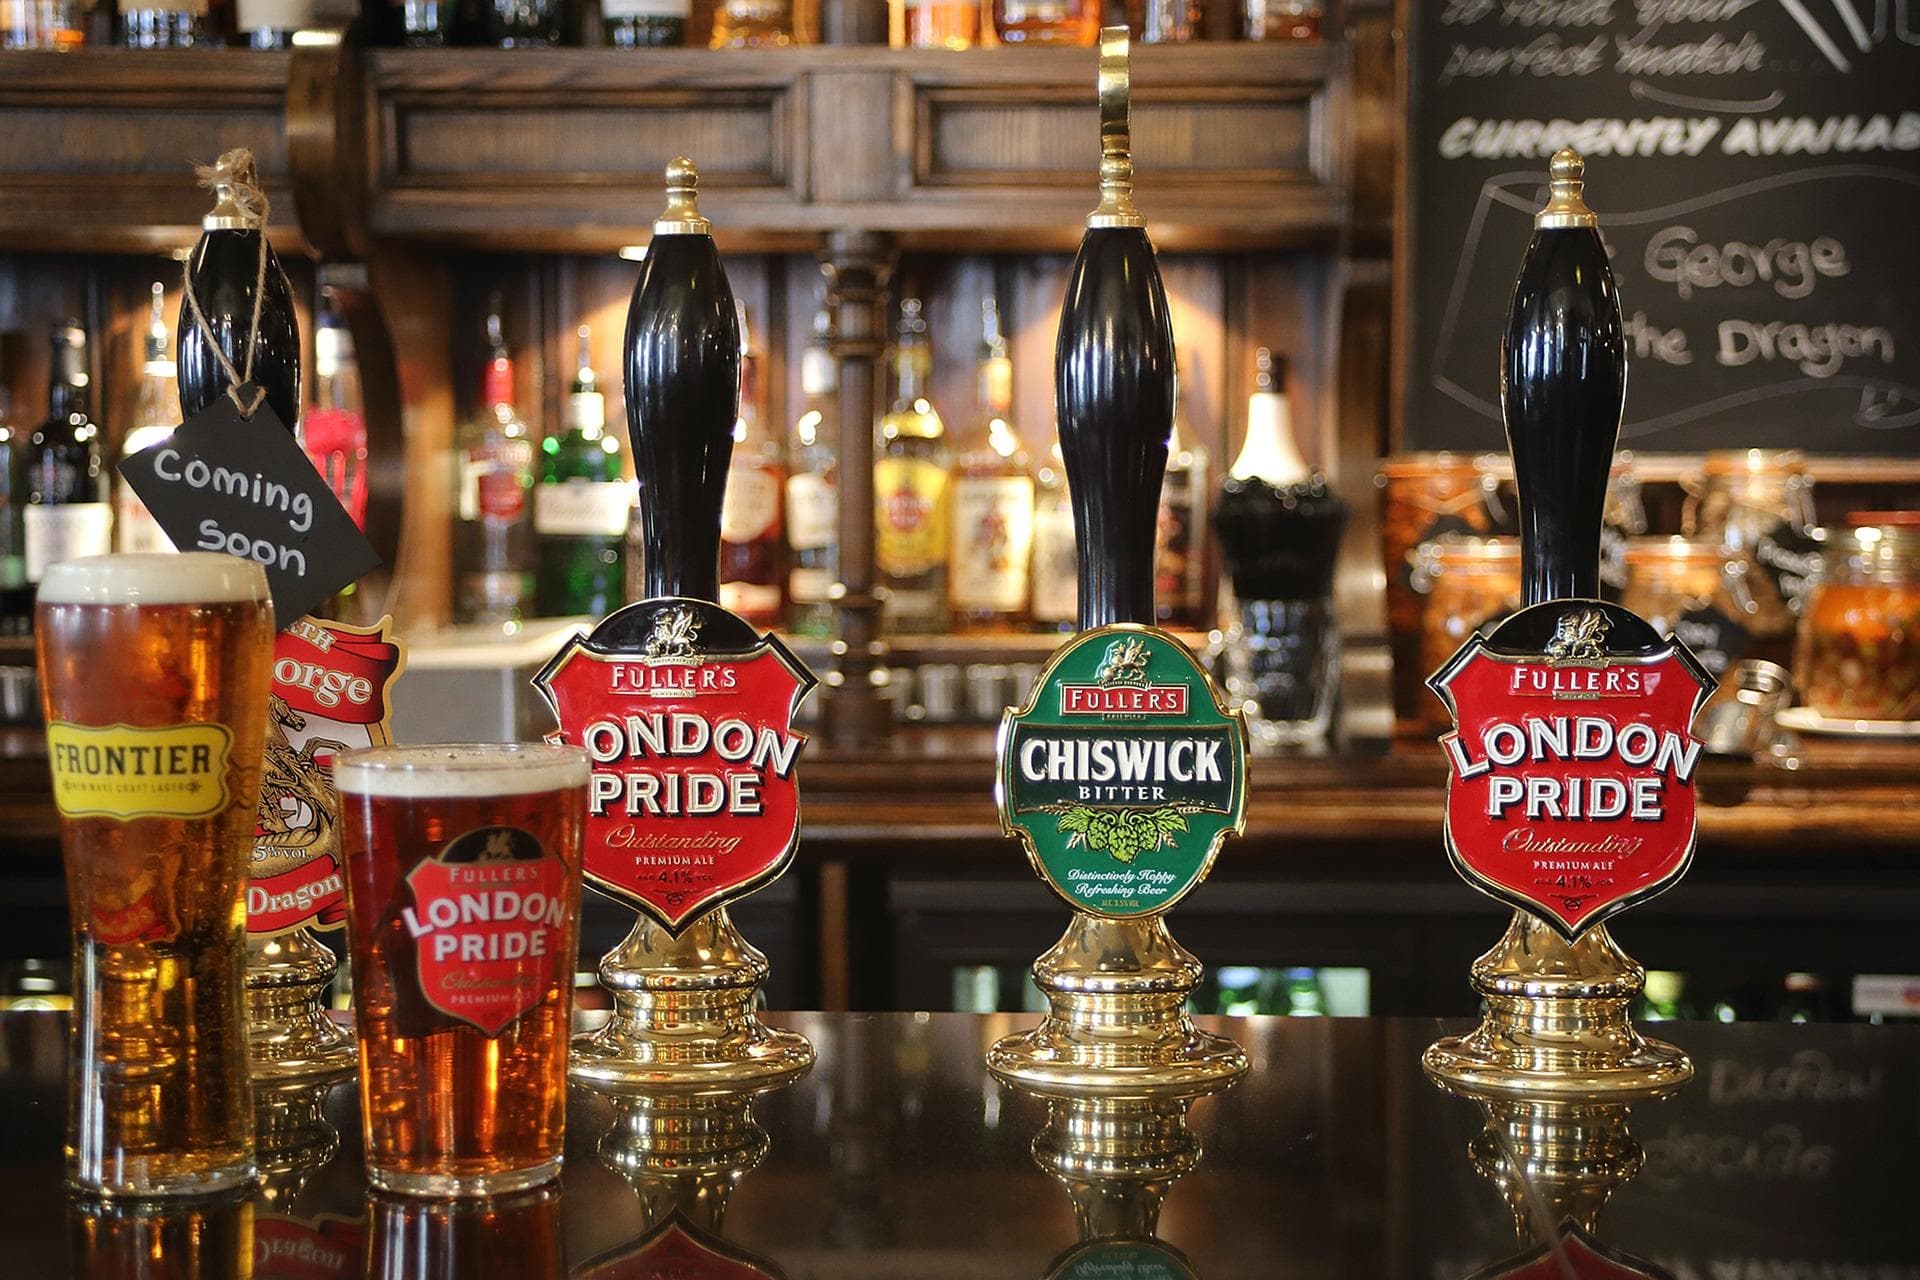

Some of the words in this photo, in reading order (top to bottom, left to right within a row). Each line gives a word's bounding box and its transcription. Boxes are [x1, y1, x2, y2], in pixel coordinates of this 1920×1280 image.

[1438, 115, 1722, 159] CURRENTLY
[1644, 225, 1850, 299] George
[1715, 318, 1896, 379] Dragon
[153, 449, 314, 532] Coming
[611, 665, 736, 688] FULLER'S
[1512, 667, 1641, 691] FULLER'S
[1071, 689, 1178, 711] FULLER'S
[55, 743, 211, 775] FRONTIER
[545, 712, 803, 777] ONDON
[1020, 738, 1224, 782] CHISWICK
[1448, 715, 1704, 782] LONDON
[589, 773, 764, 816] PRIDE
[1078, 786, 1167, 800] BITTER
[1488, 776, 1664, 819] PRIDE
[605, 824, 743, 854] Outstanding
[1502, 828, 1644, 859] Outstanding
[635, 856, 691, 865] PREMIUM
[694, 855, 715, 865] ALE
[1067, 868, 1136, 884] Distinctively
[1136, 869, 1176, 884] Hoppy
[1533, 861, 1590, 870] PREMIUM
[1592, 861, 1614, 870] ALE
[247, 874, 342, 914] Dragon
[1075, 882, 1135, 898] Refreshing
[1137, 883, 1168, 895] Beer
[402, 891, 566, 939] LONDON
[434, 930, 548, 962] PRIDE
